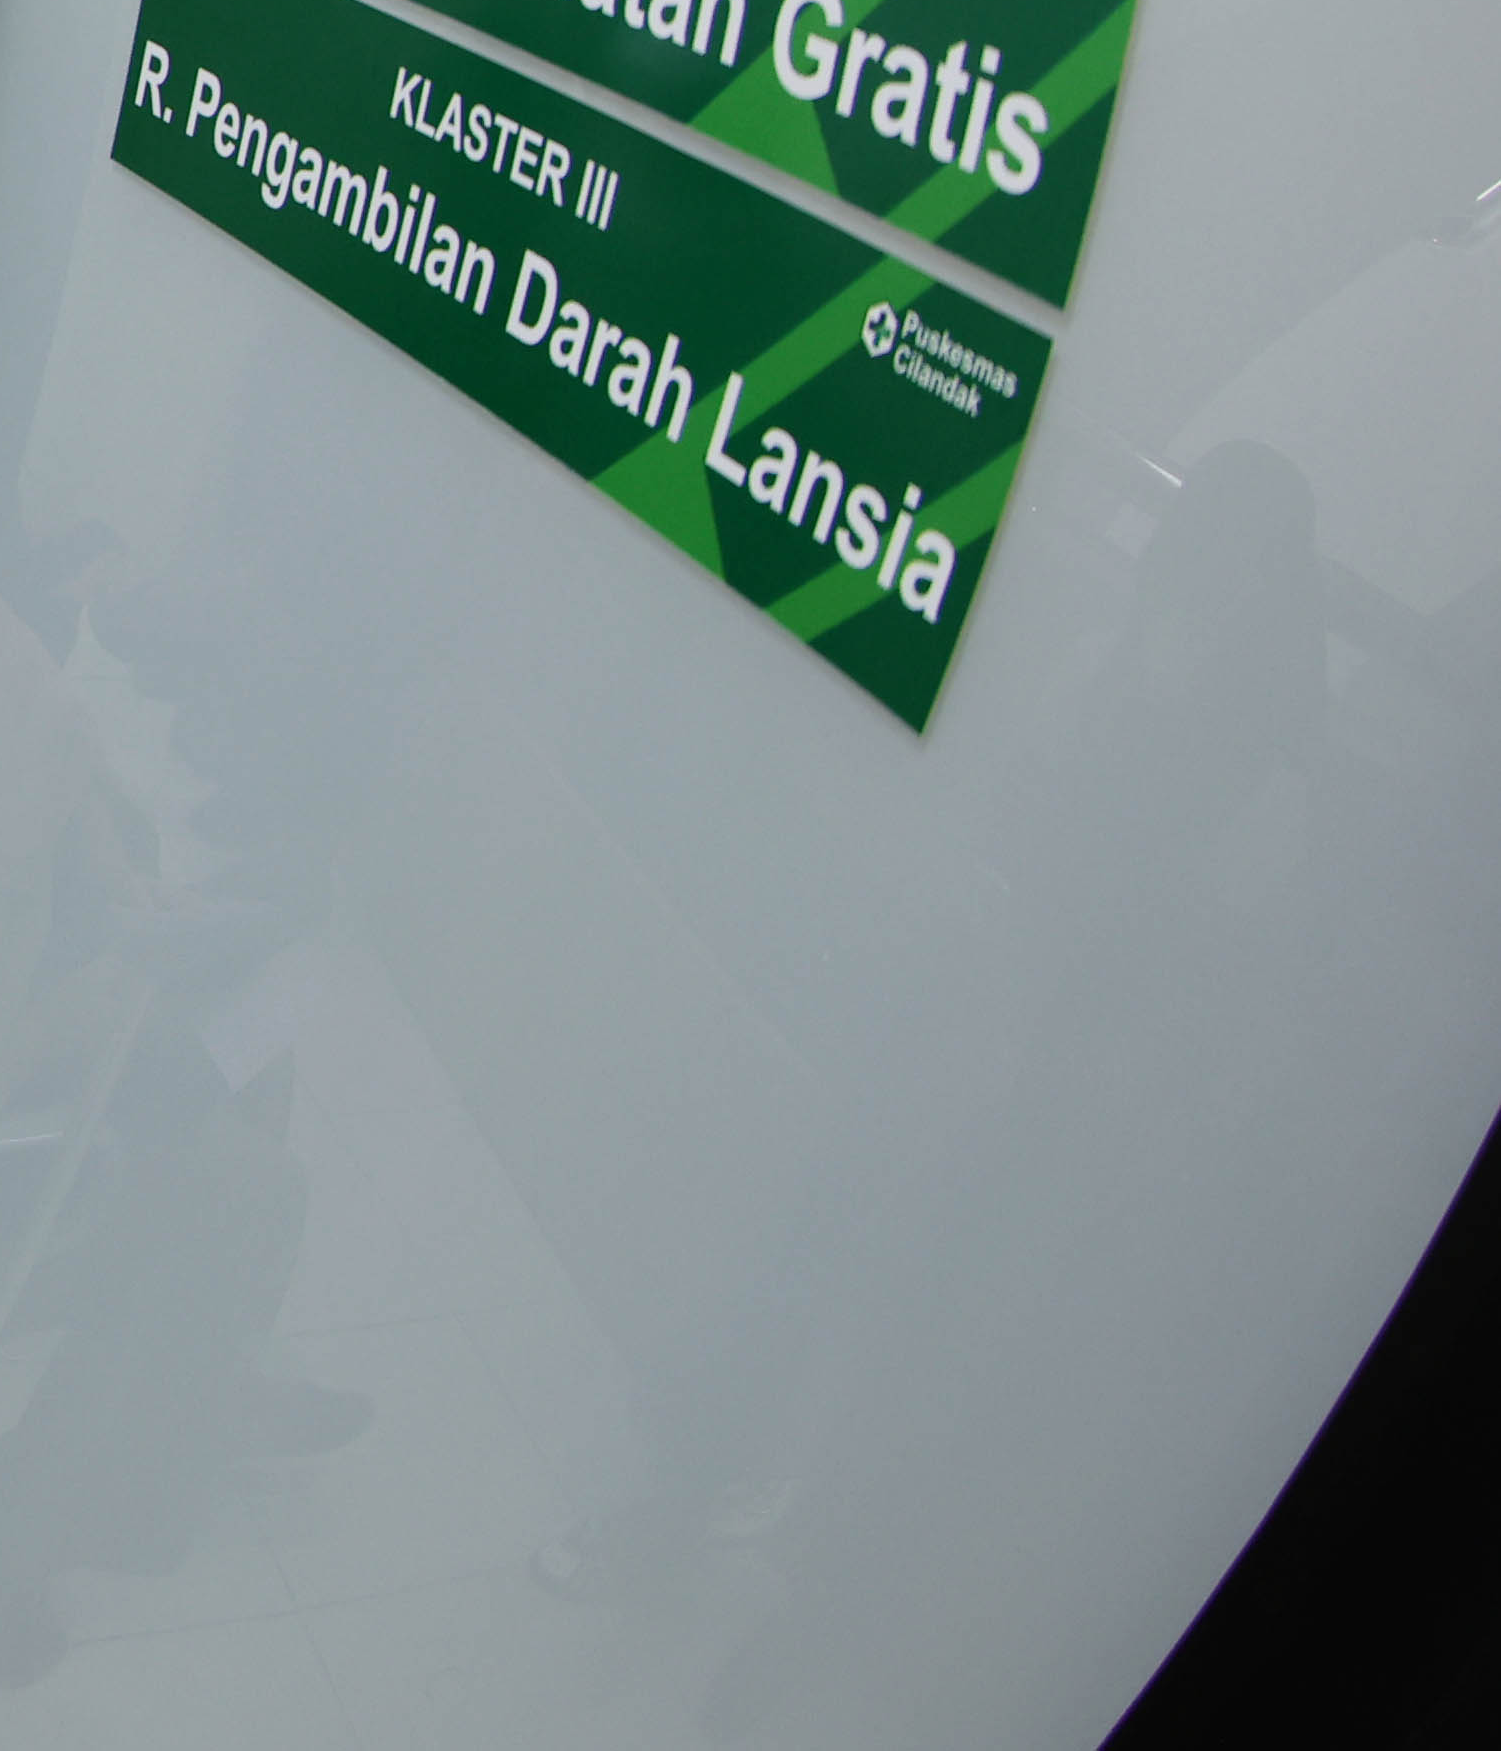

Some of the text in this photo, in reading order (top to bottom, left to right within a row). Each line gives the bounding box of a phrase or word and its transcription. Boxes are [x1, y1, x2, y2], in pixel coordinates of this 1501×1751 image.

[390, 67, 619, 231] KLASTER III
[135, 39, 955, 624] R. Pengambilan Darah Lansia
[893, 344, 981, 418] Cilandak
[902, 310, 1018, 398] Puskesmas
